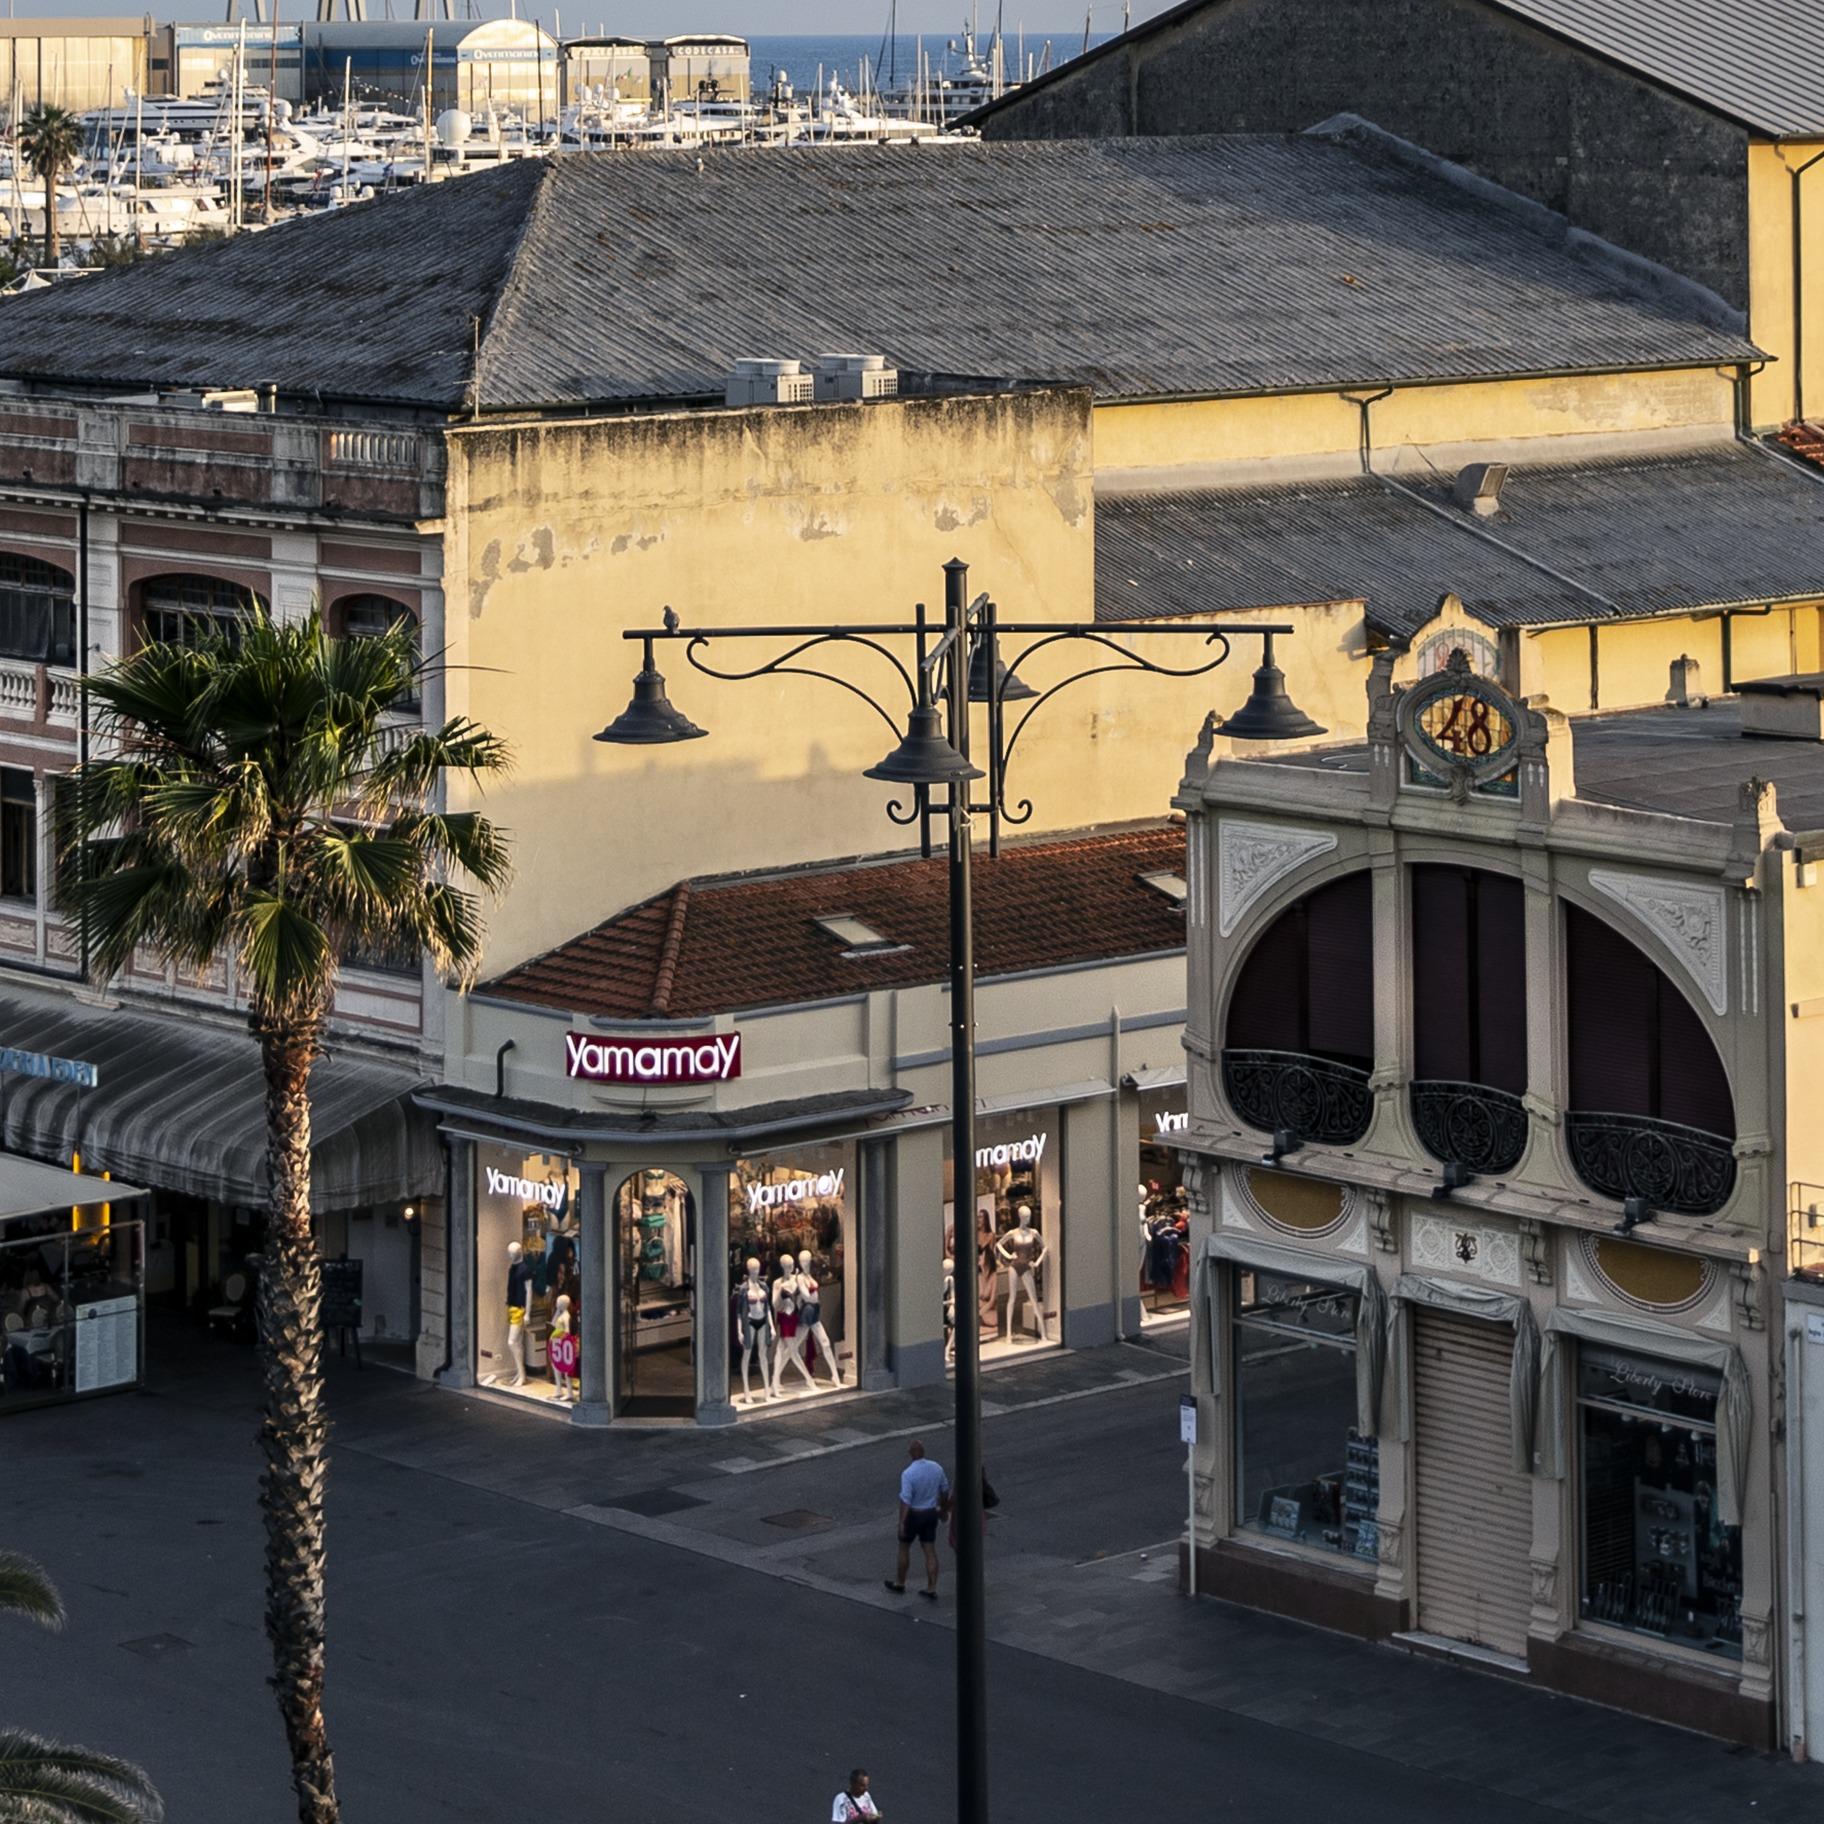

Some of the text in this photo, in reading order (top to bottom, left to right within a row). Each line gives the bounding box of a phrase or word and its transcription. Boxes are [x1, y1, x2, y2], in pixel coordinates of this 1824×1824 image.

[678, 46, 734, 55] CODECASA
[1436, 697, 1492, 755] 48
[551, 1338, 574, 1366] 50
[1610, 1360, 1713, 1401] Liberty Store
